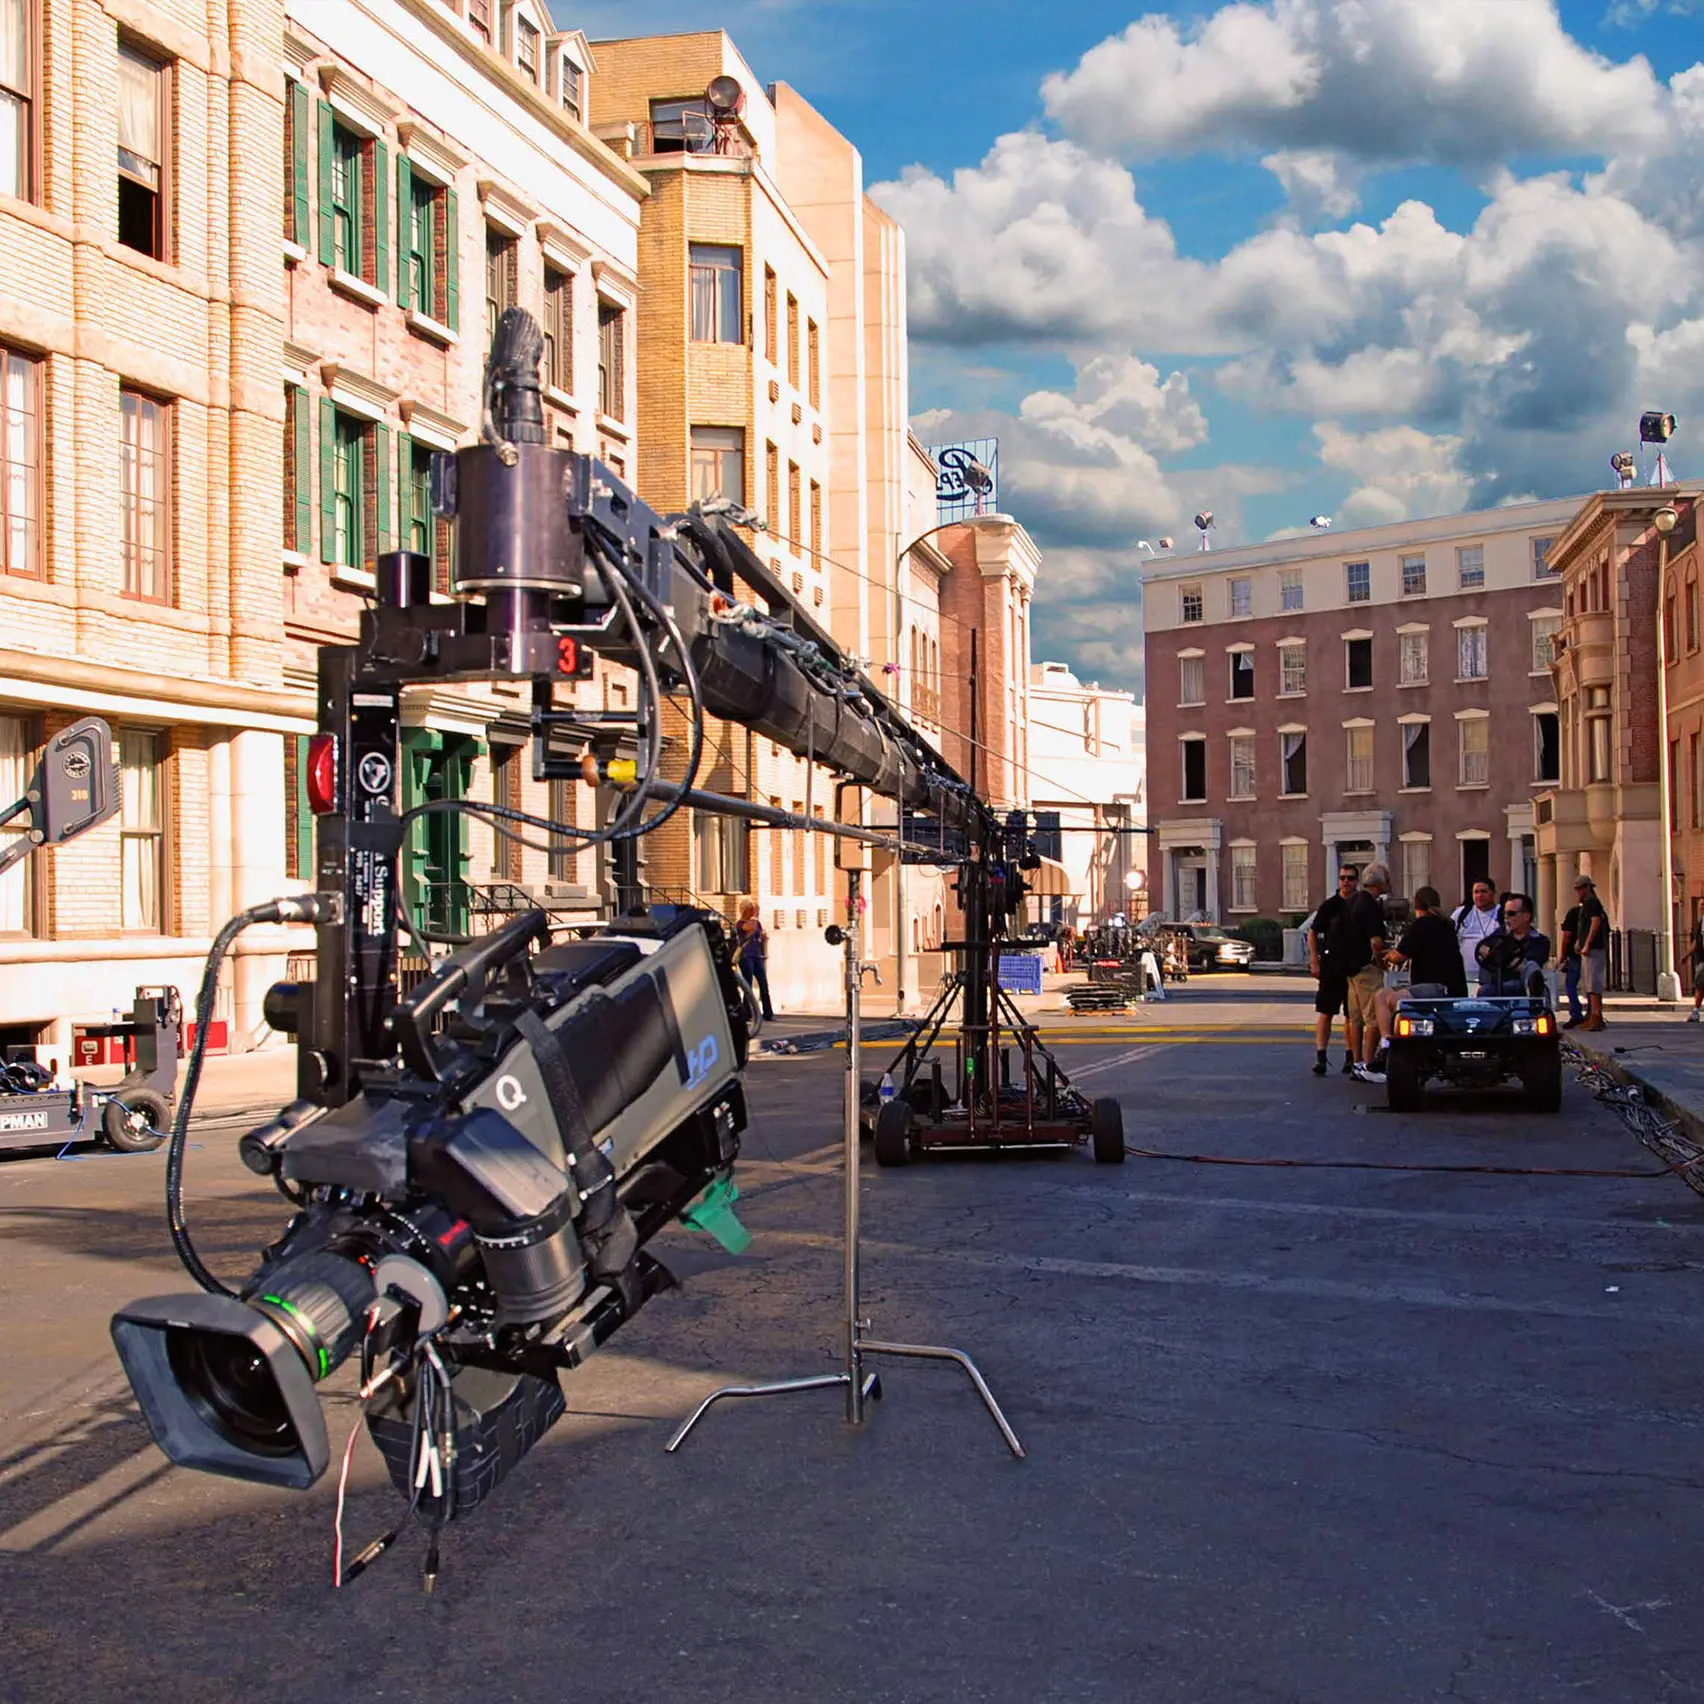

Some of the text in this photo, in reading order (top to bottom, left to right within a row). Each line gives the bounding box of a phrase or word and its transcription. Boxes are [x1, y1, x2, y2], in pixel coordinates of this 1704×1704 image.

[557, 636, 577, 674] 3
[371, 866, 388, 936] Support
[495, 1075, 527, 1110] Q
[0, 1114, 46, 1130] PMAN
